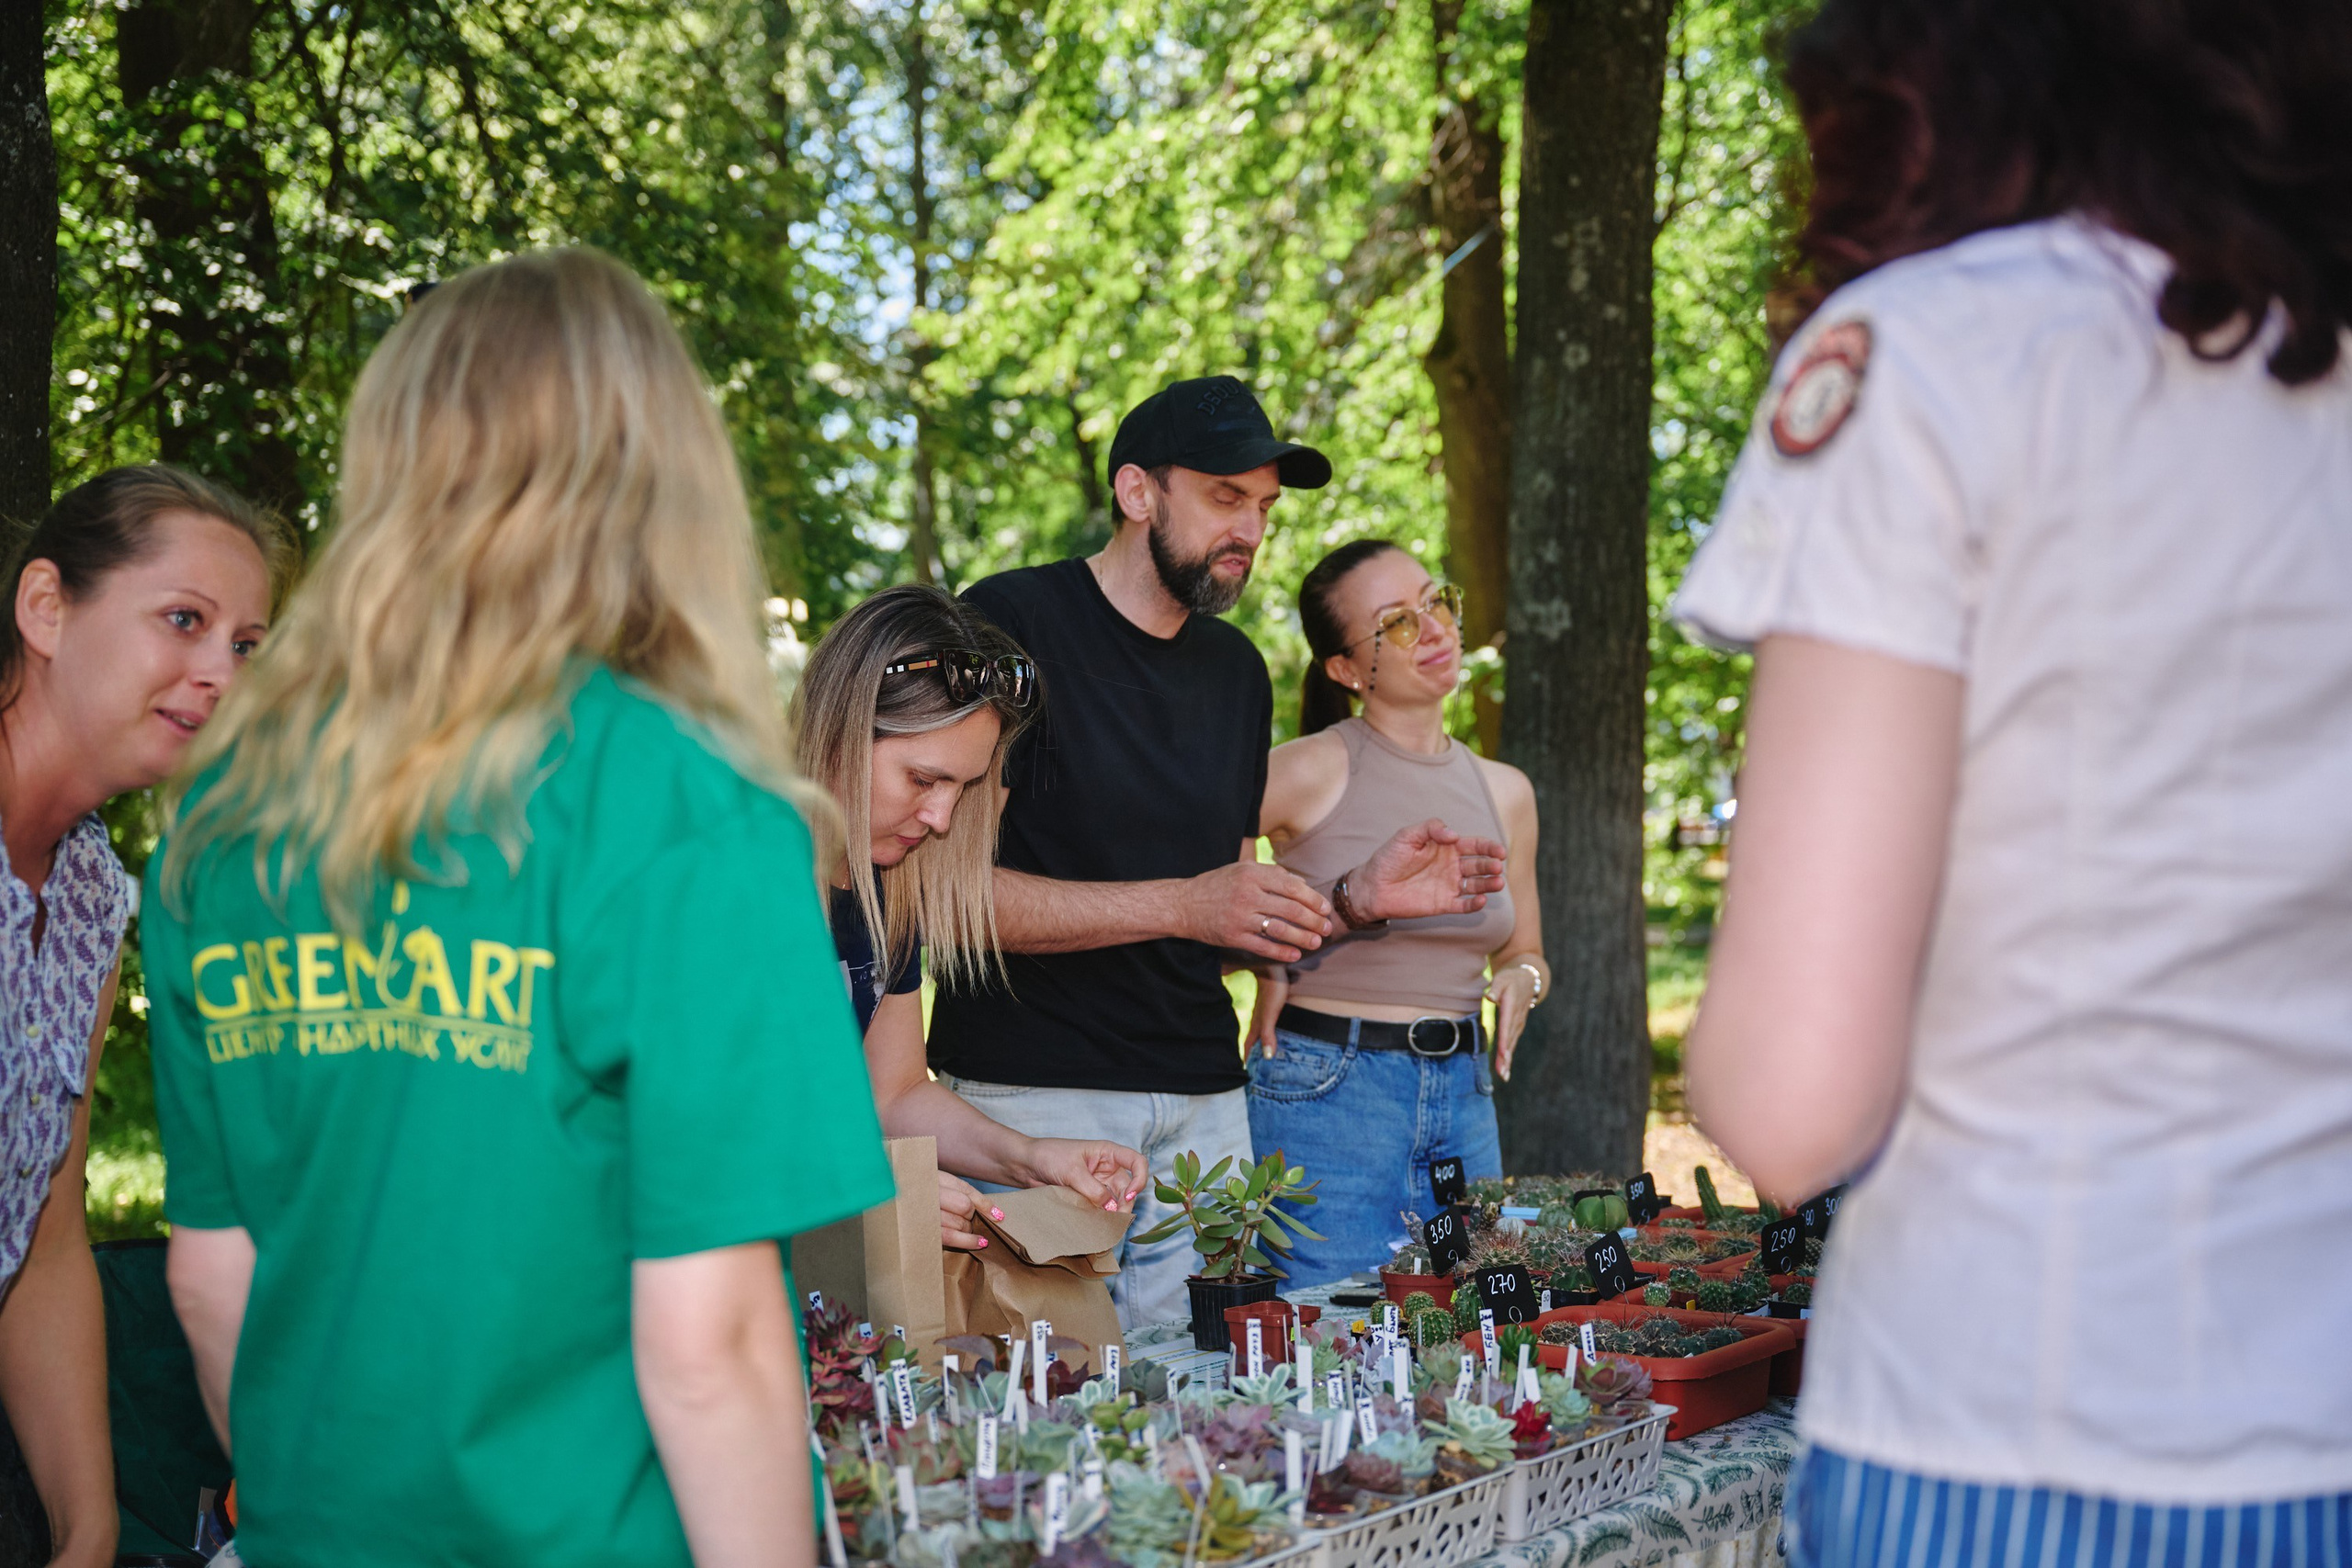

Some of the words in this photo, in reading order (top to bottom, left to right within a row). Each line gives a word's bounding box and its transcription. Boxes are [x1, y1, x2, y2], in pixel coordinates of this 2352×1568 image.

[1434, 1163, 1456, 1184] 400
[1630, 1180, 1645, 1201] 350
[1430, 1214, 1453, 1245] 350
[1770, 1227, 1796, 1253] 250
[1594, 1246, 1618, 1273] 250
[1487, 1273, 1516, 1295] 270
